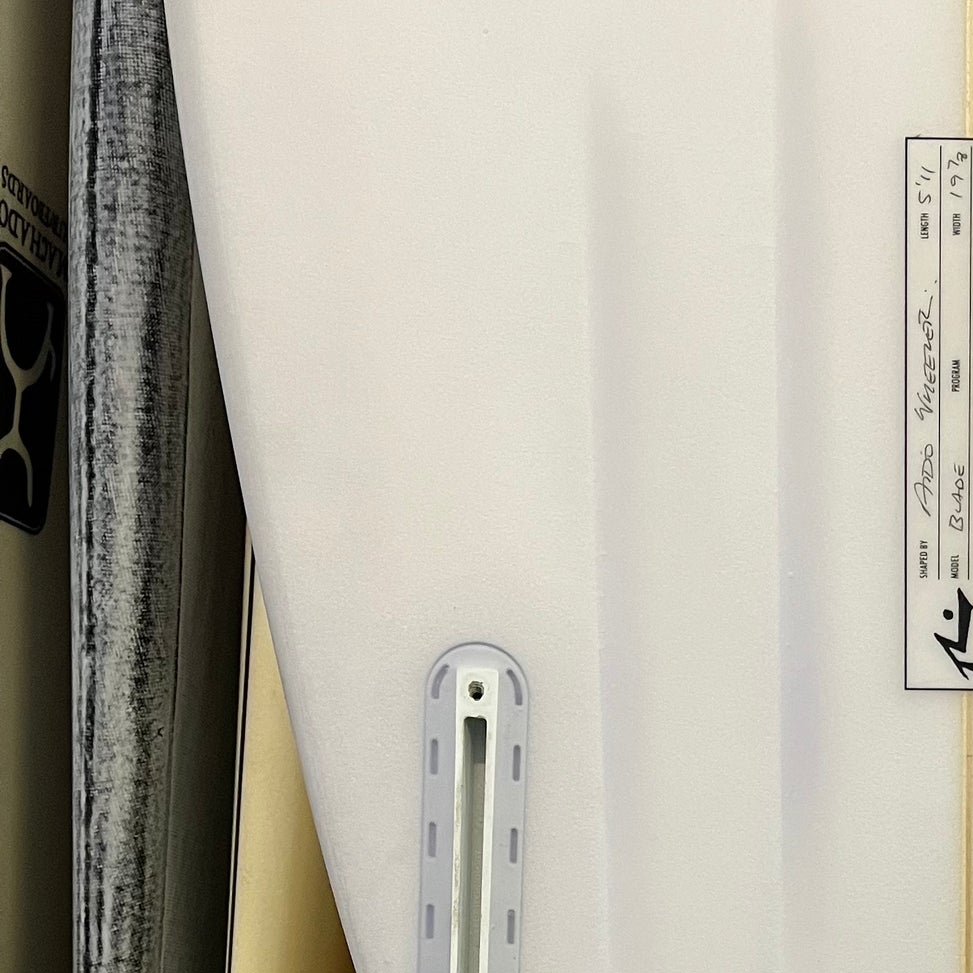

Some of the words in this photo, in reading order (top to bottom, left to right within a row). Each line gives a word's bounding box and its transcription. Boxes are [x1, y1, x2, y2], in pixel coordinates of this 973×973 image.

[921, 213, 929, 239] LENGTH
[953, 214, 961, 235] WIDTH
[952, 360, 960, 392] PROGRAM
[949, 464, 964, 531] BLADE
[920, 541, 928, 549] BY
[919, 551, 928, 579] SHAPED
[951, 555, 959, 579] MODEL
